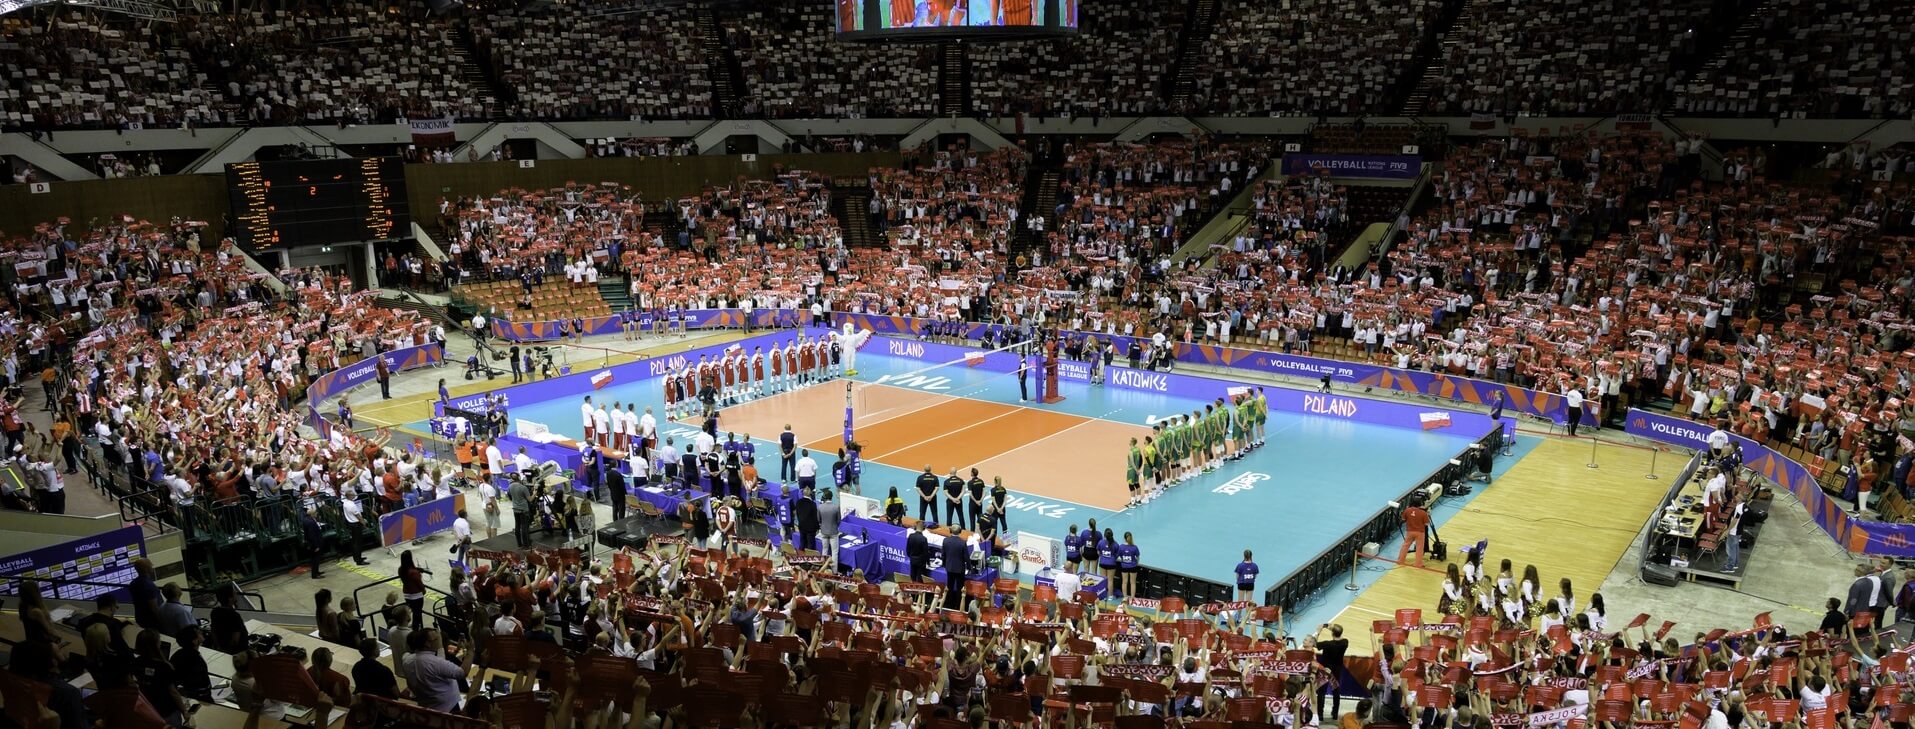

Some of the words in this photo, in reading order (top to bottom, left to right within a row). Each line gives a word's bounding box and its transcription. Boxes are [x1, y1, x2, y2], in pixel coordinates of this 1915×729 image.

[1308, 159, 1367, 169] VOLLEYBALL
[1878, 171, 1886, 179] K
[309, 187, 316, 195] 2
[890, 340, 925, 358] POLAND
[650, 354, 686, 377] POLAND
[1058, 363, 1088, 374] LEYBALL
[1270, 358, 1319, 373] VOLLEYBALL
[1338, 367, 1354, 376] FIVB
[347, 365, 377, 381] VOLLEYBALL
[1068, 371, 1088, 380] LEAGUE
[1112, 369, 1168, 391] KATOWICE
[1304, 394, 1357, 417] POLAND
[1633, 417, 1648, 429] VNL
[427, 508, 446, 526] VNL
[880, 544, 906, 558] EYBALL
[0, 557, 33, 570] LLEYBALL
